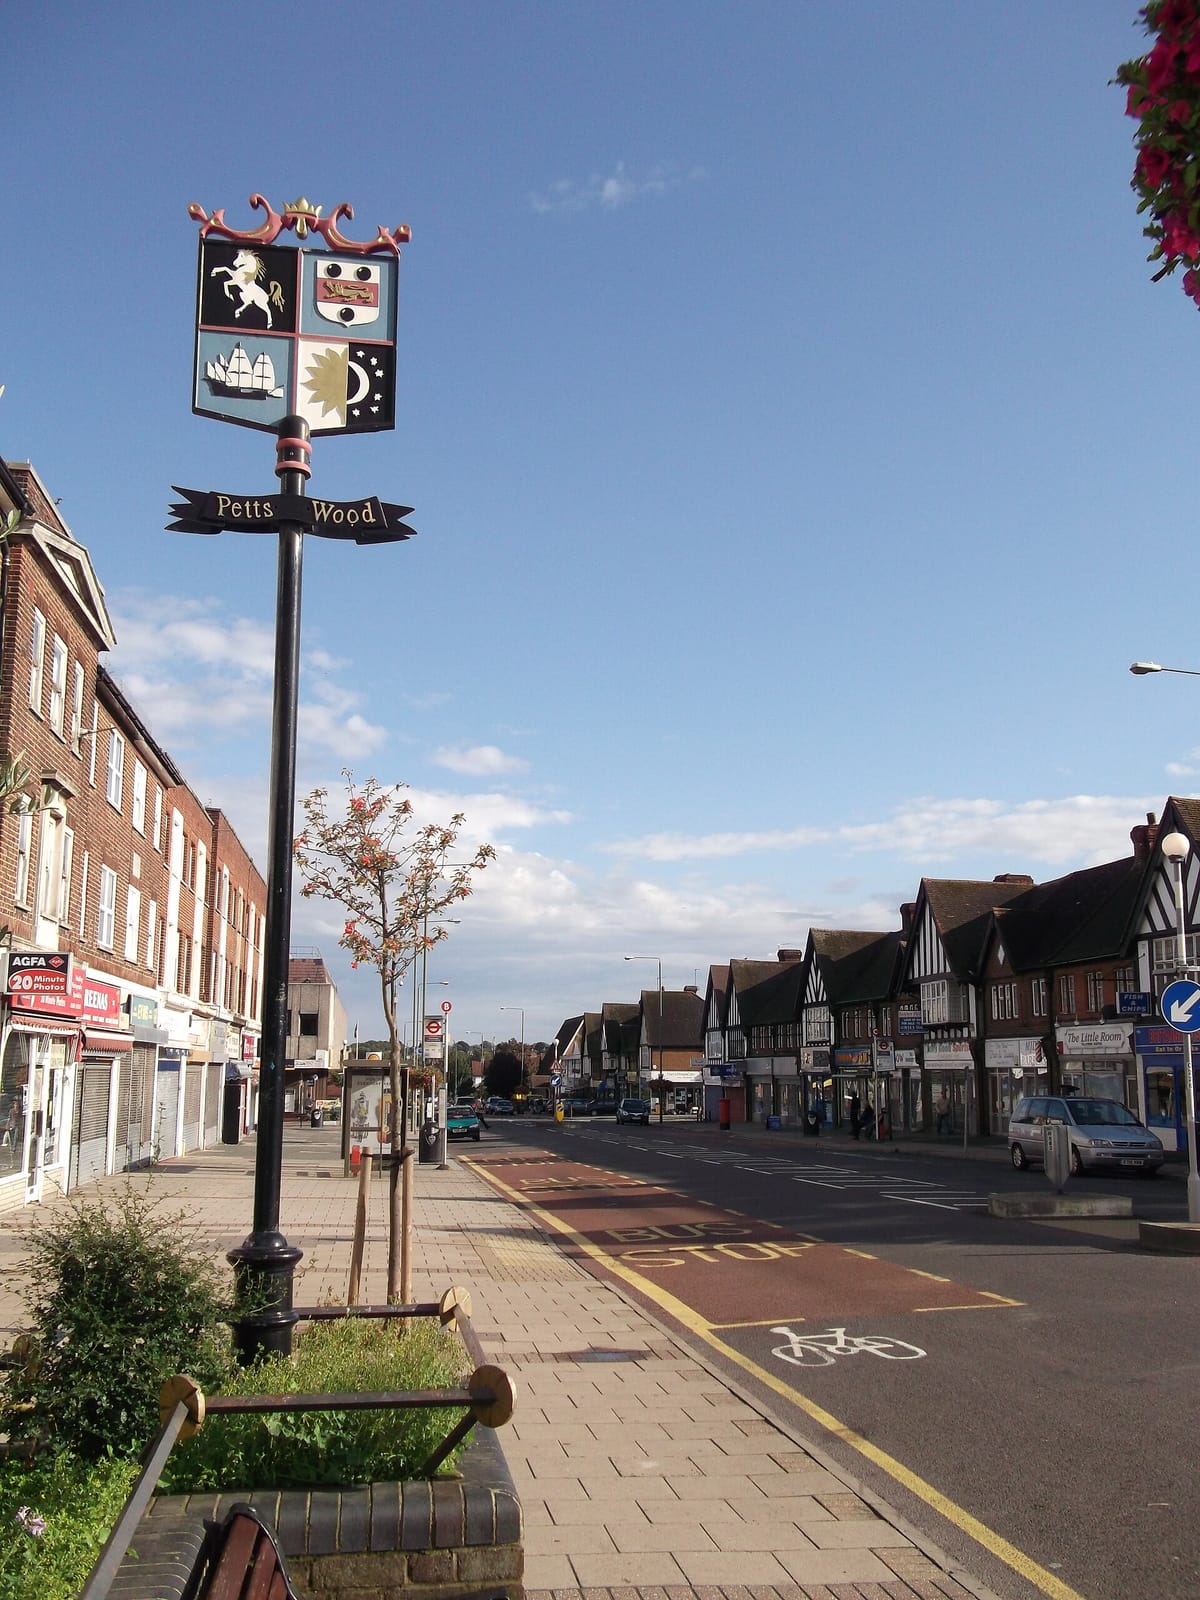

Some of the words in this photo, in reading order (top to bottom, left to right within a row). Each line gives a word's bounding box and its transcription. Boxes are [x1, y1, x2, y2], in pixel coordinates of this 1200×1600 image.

[216, 495, 274, 518] Petts
[311, 499, 377, 526] Wood
[12, 956, 46, 966] AGFA
[12, 974, 33, 991] 20
[34, 975, 65, 983] Minute
[33, 983, 65, 991] Photos
[1068, 1033, 1079, 1042] The
[1081, 1032, 1099, 1042] Little
[1100, 1031, 1121, 1041] Room
[605, 1222, 753, 1243] BUS
[621, 1241, 817, 1268] STOP
